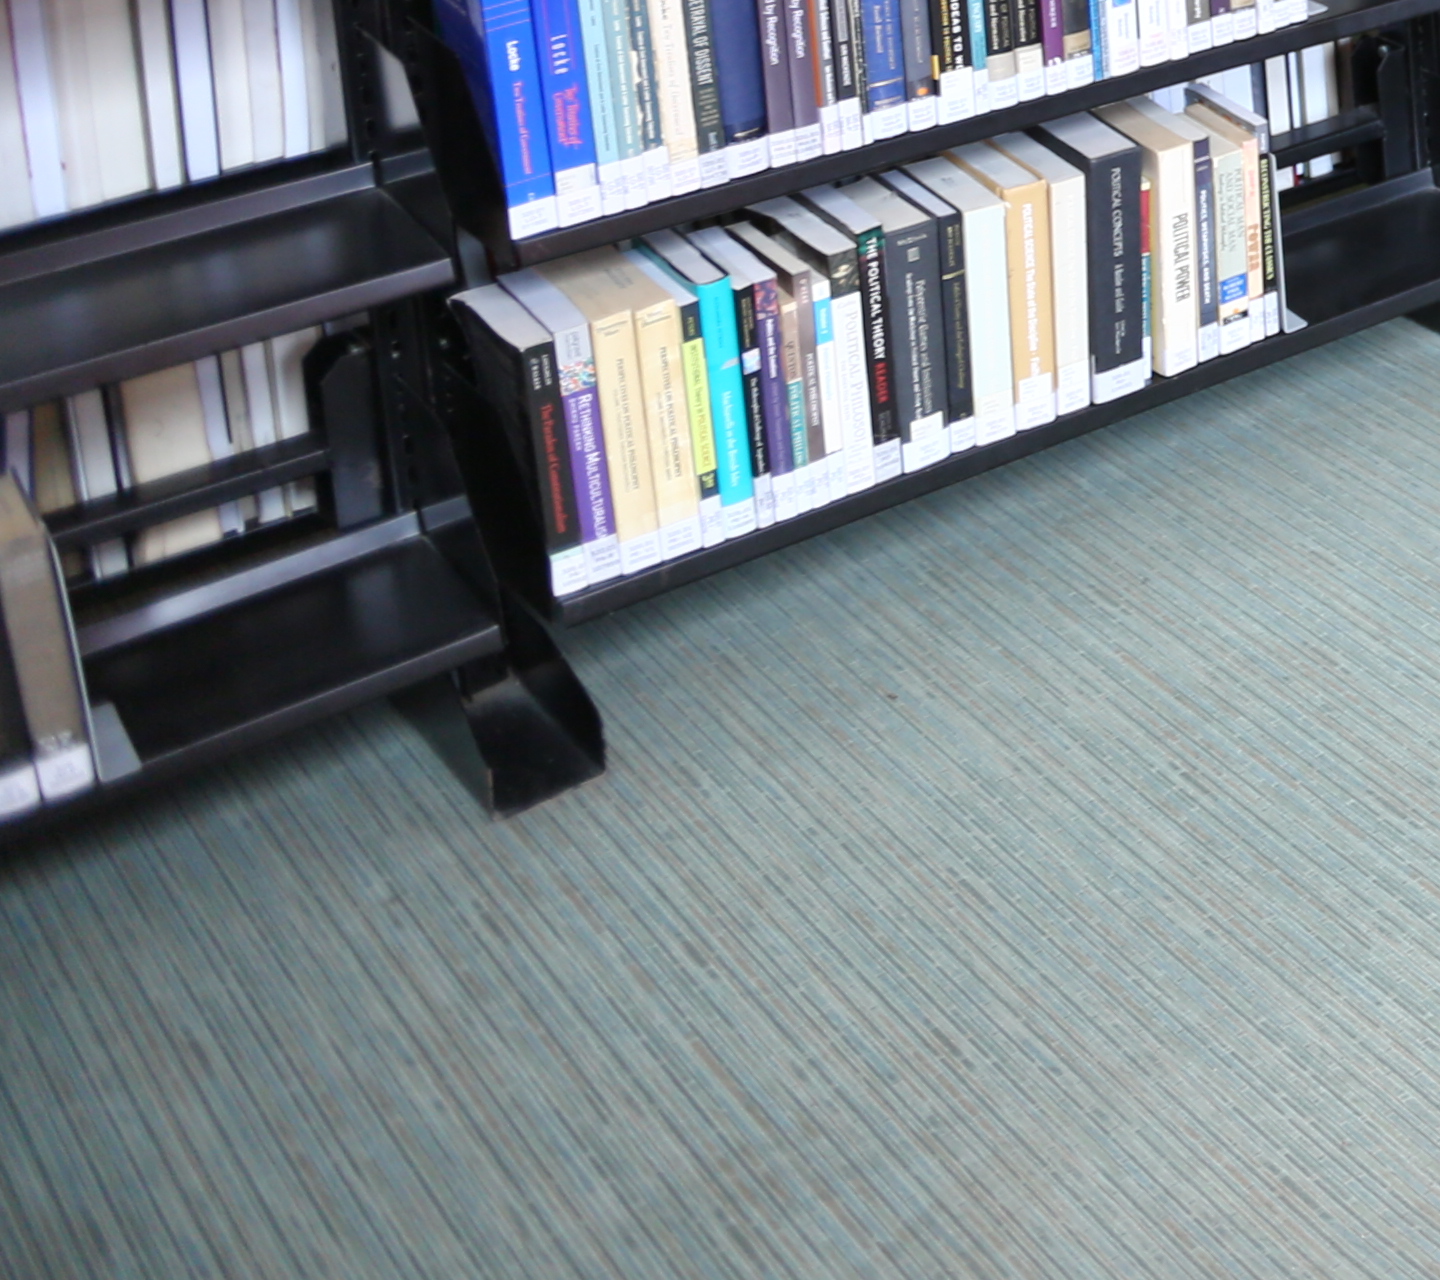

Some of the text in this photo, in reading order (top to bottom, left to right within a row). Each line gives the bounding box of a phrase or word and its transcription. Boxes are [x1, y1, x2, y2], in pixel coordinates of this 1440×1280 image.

[505, 40, 520, 71] Locke
[695, 49, 713, 86] DISSENT
[765, 16, 780, 65] Recognition
[1109, 167, 1124, 257] POLITICAL CONCEPTS
[1172, 213, 1191, 303] POLITICAL POWER
[866, 237, 888, 403] THE POLITICAL THEORY READER
[576, 393, 595, 452] RETHINKING
